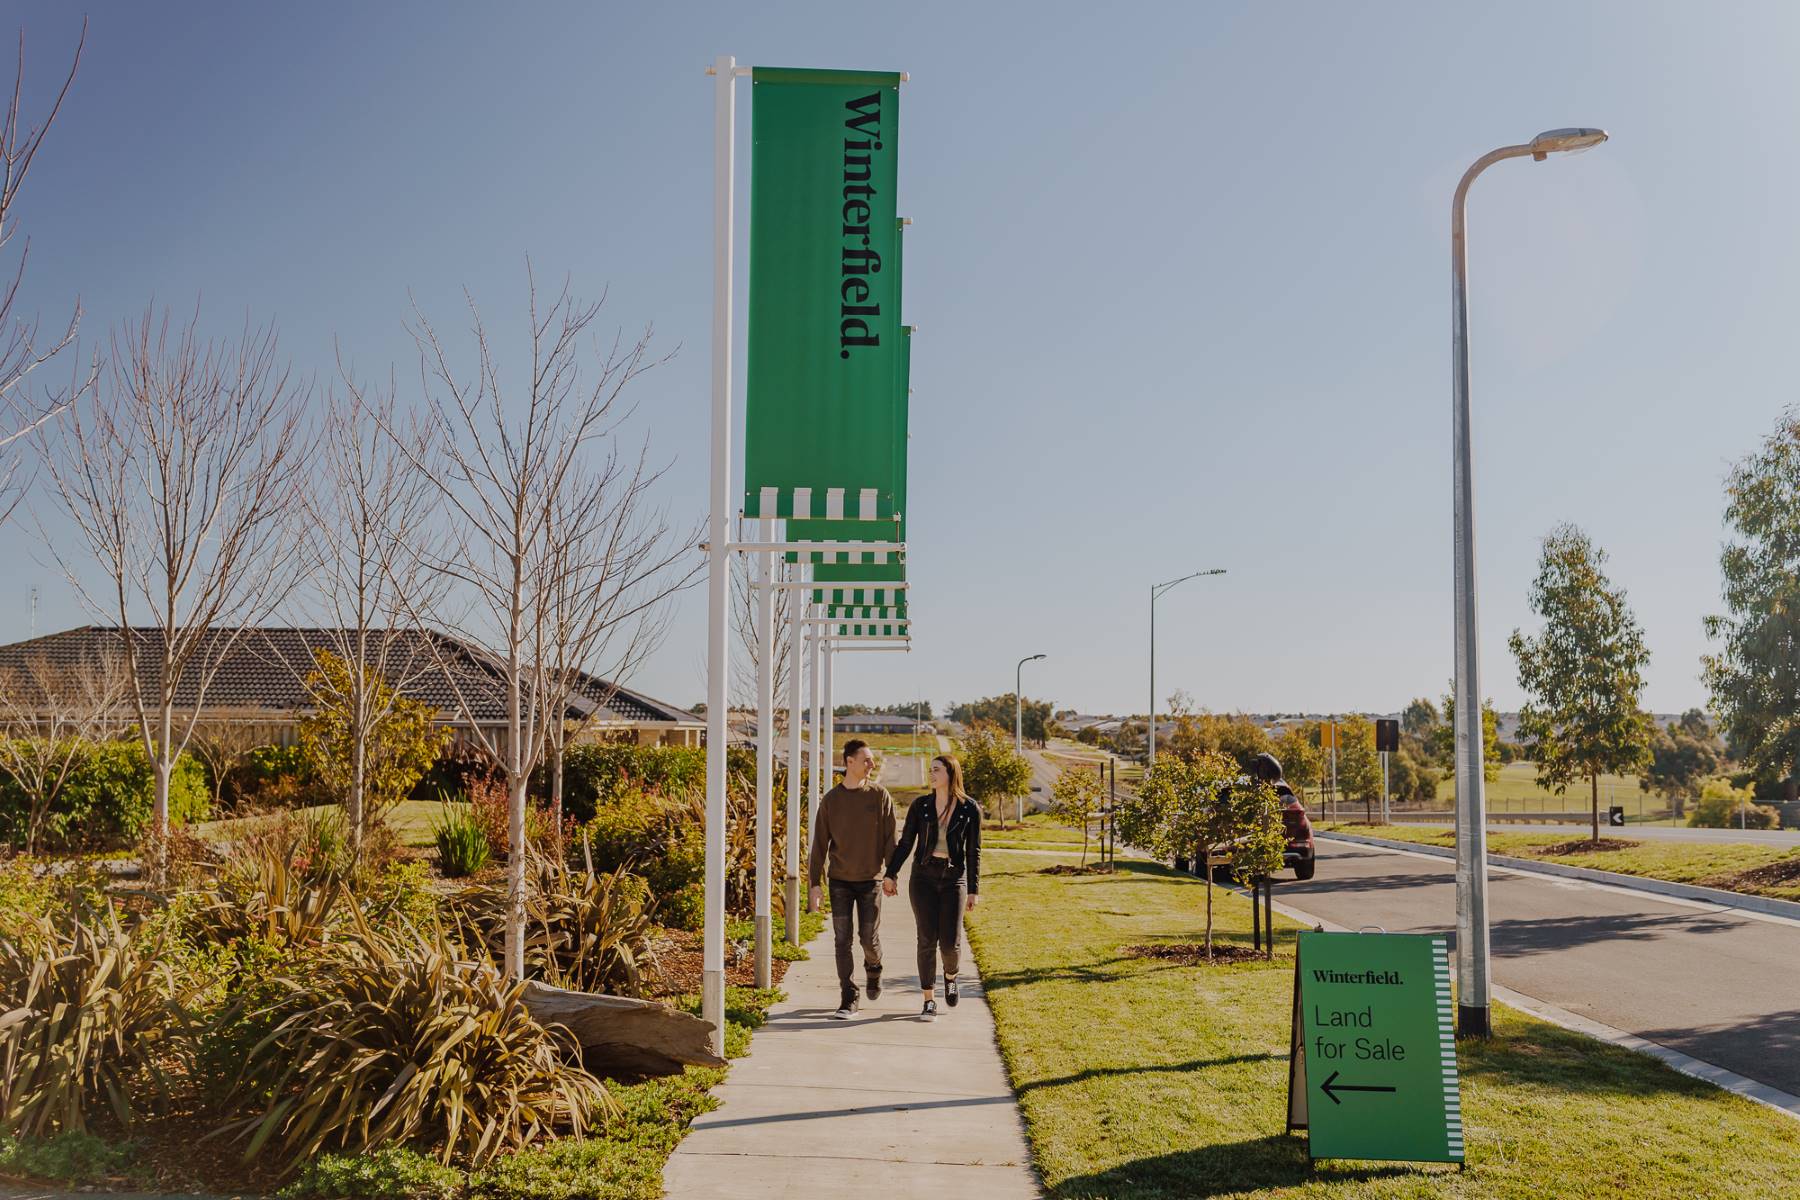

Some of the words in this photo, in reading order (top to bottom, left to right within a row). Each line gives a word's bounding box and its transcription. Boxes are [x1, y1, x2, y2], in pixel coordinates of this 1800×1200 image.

[840, 90, 883, 360] Winterfield.
[1313, 970, 1404, 985] Winterfield.
[1315, 1004, 1372, 1028] Land
[1315, 1036, 1347, 1060] for
[1355, 1037, 1406, 1061] Sale
